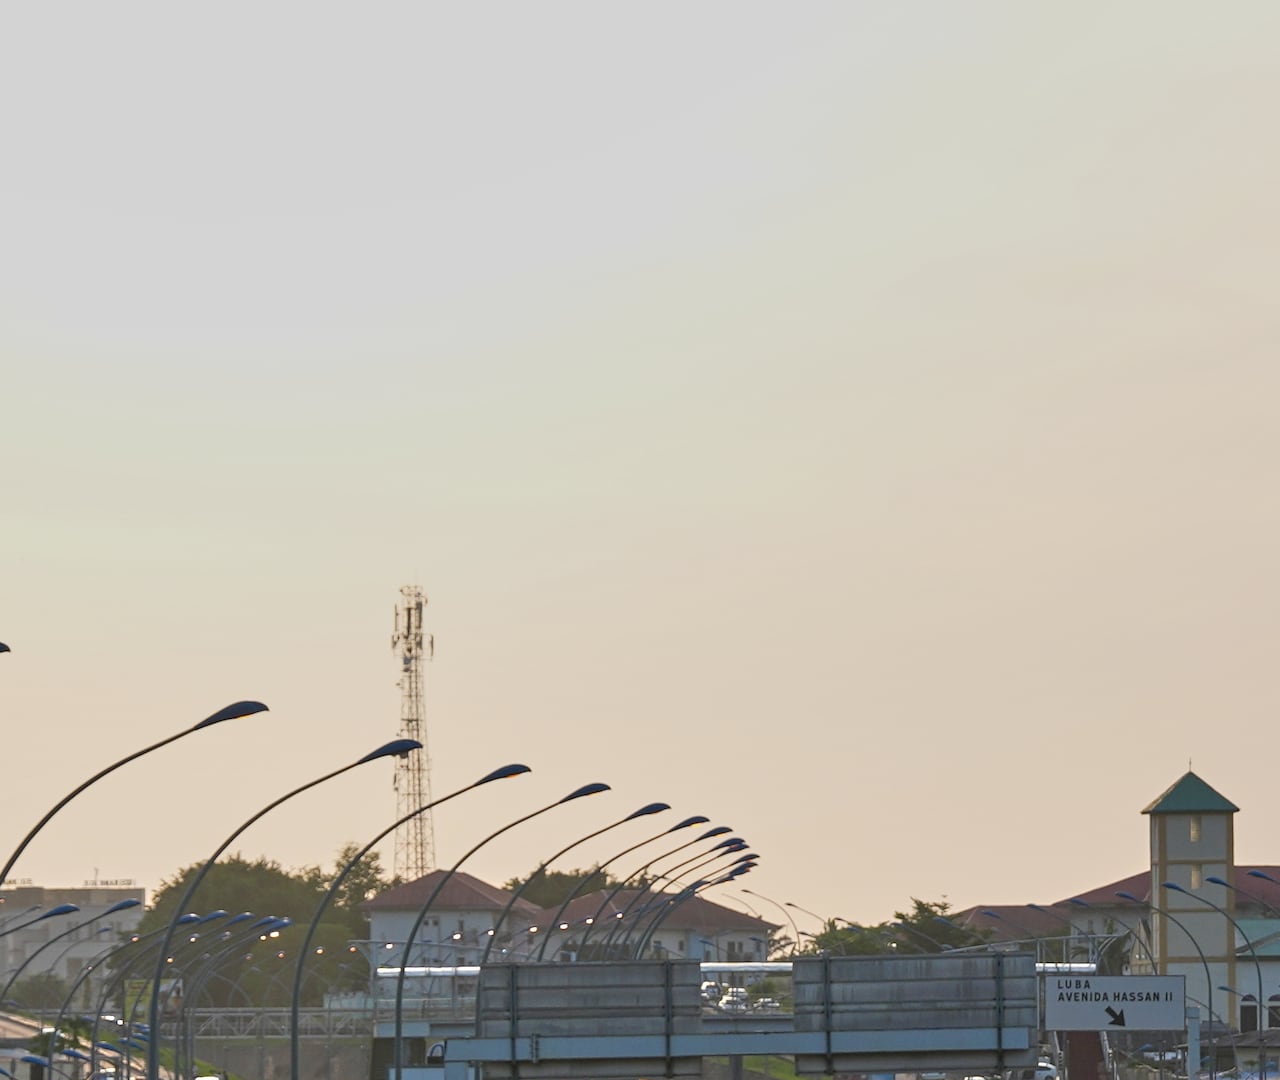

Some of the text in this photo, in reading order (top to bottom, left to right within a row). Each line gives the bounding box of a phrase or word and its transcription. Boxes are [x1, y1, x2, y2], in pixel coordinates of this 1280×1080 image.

[1057, 979, 1091, 990] LUBA
[1058, 991, 1173, 1002] AVENIDA HASSAN II
